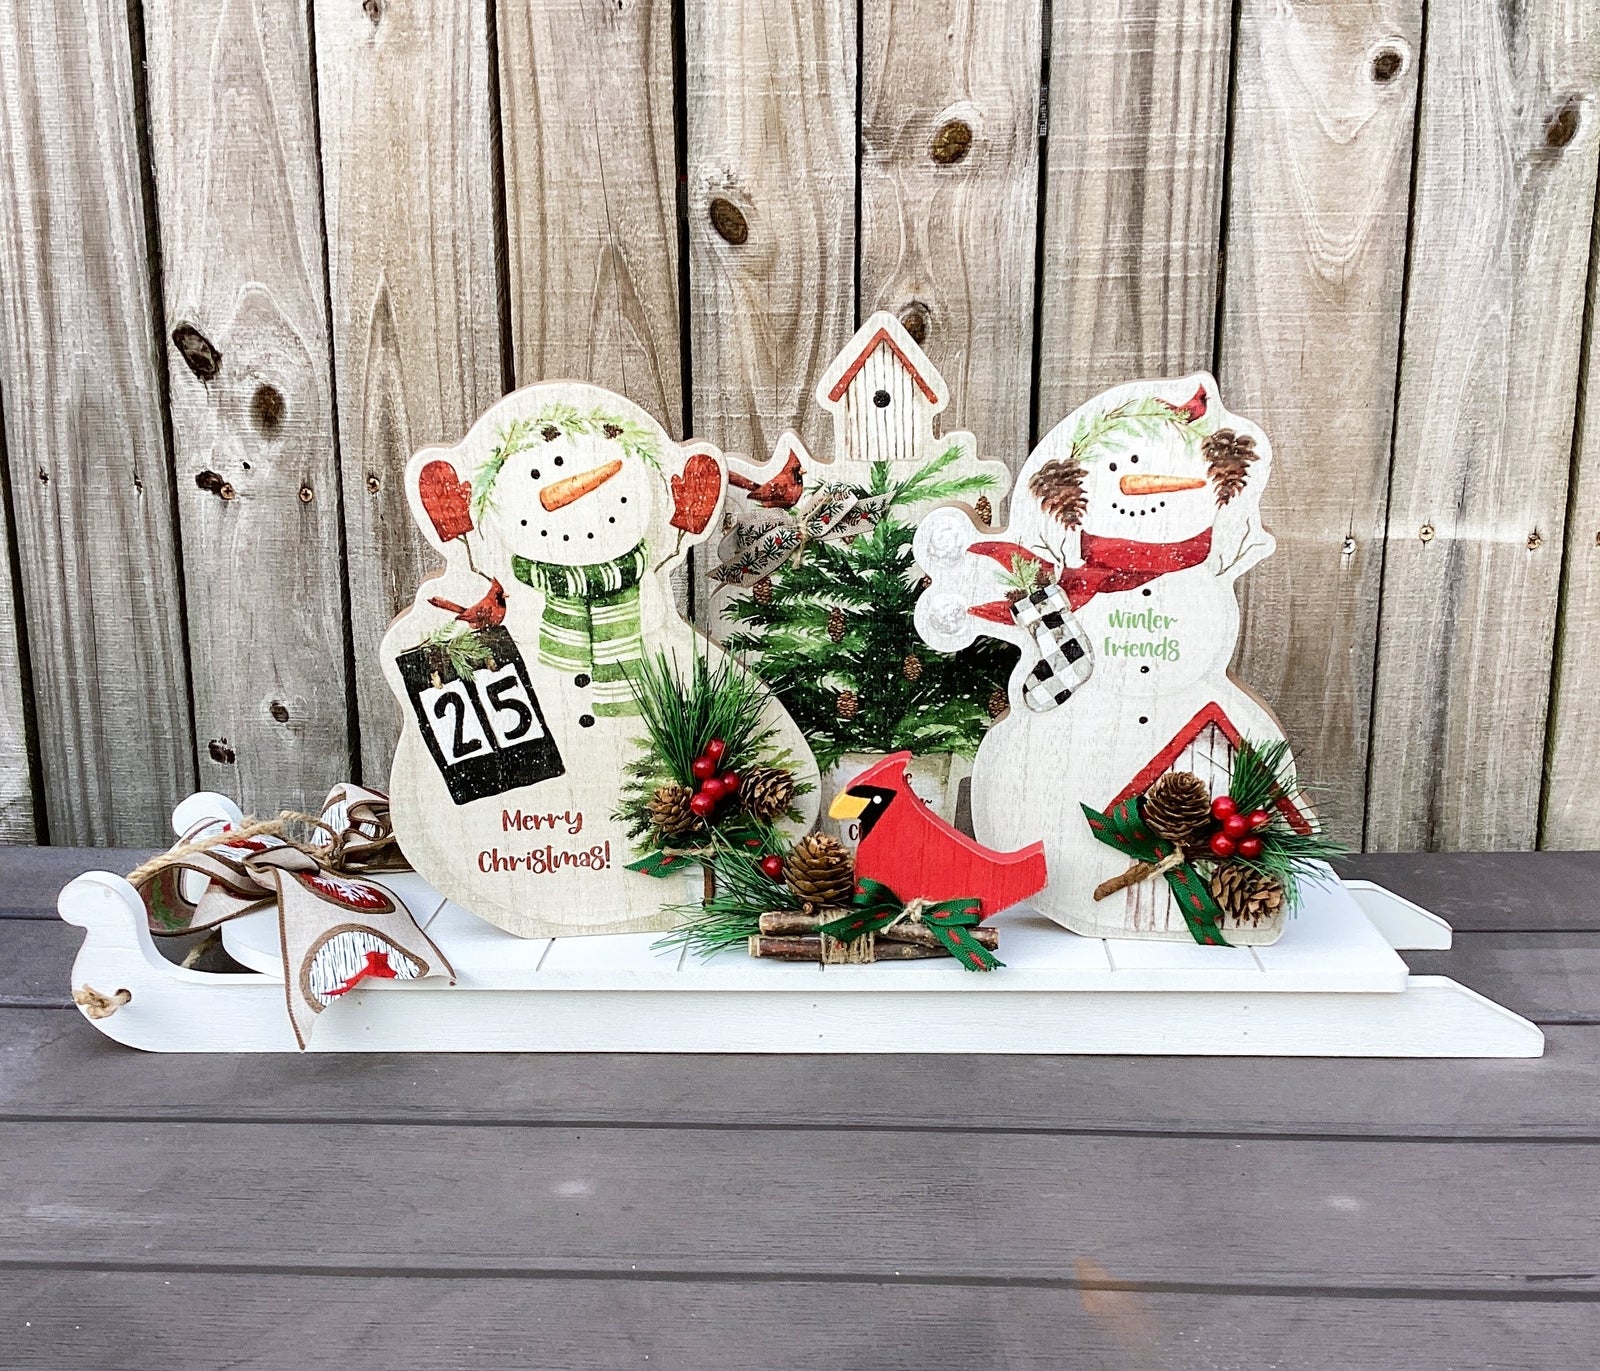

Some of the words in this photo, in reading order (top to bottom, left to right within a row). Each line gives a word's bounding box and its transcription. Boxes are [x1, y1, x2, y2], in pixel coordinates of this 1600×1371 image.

[1108, 607, 1179, 633] Winter
[434, 675, 533, 758] 25
[502, 809, 583, 834] Merry
[477, 840, 611, 874] Christmas!
